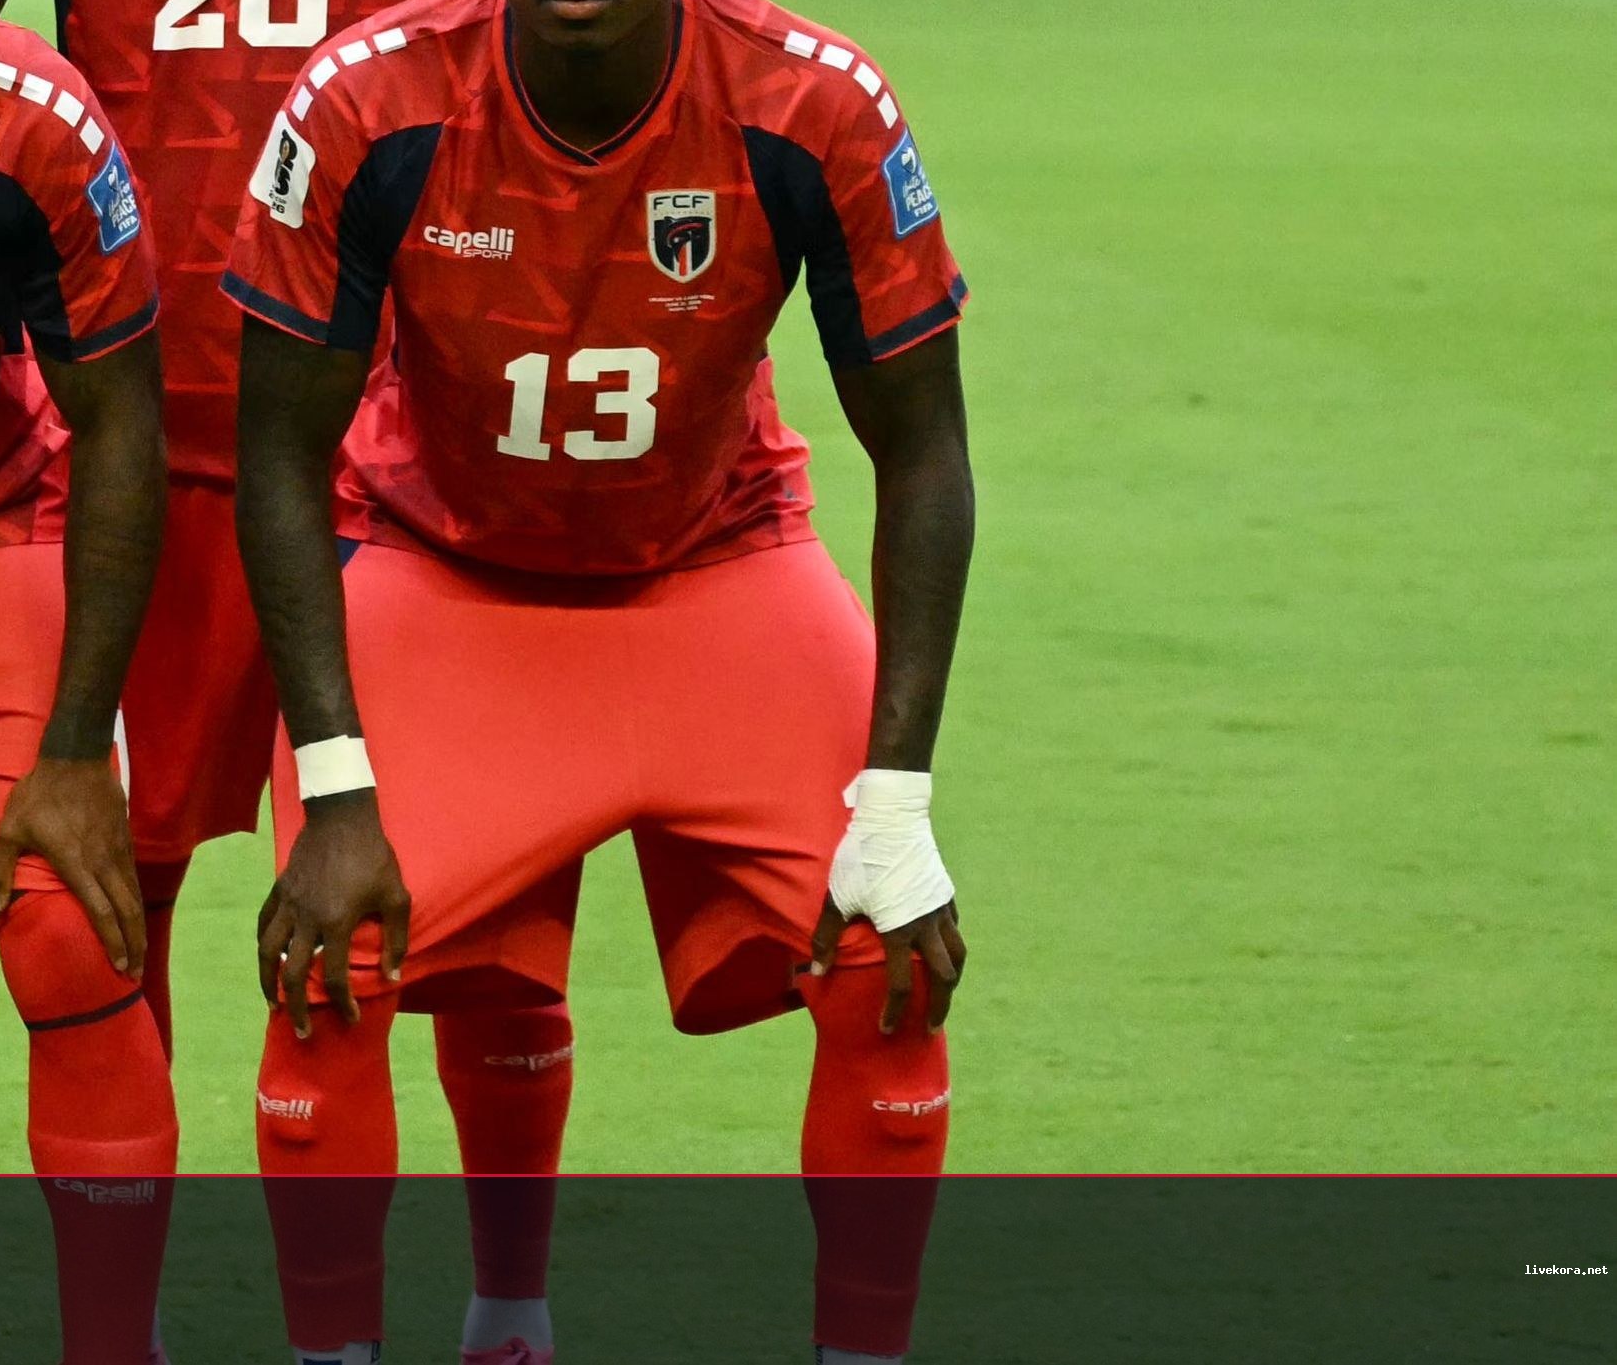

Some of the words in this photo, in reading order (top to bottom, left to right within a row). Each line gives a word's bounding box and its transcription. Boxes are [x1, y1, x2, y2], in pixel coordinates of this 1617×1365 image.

[653, 194, 710, 211] FCF
[905, 185, 933, 213] PEAC
[423, 224, 515, 255] capelli
[462, 248, 514, 261] SPORT
[496, 347, 661, 462] 13
